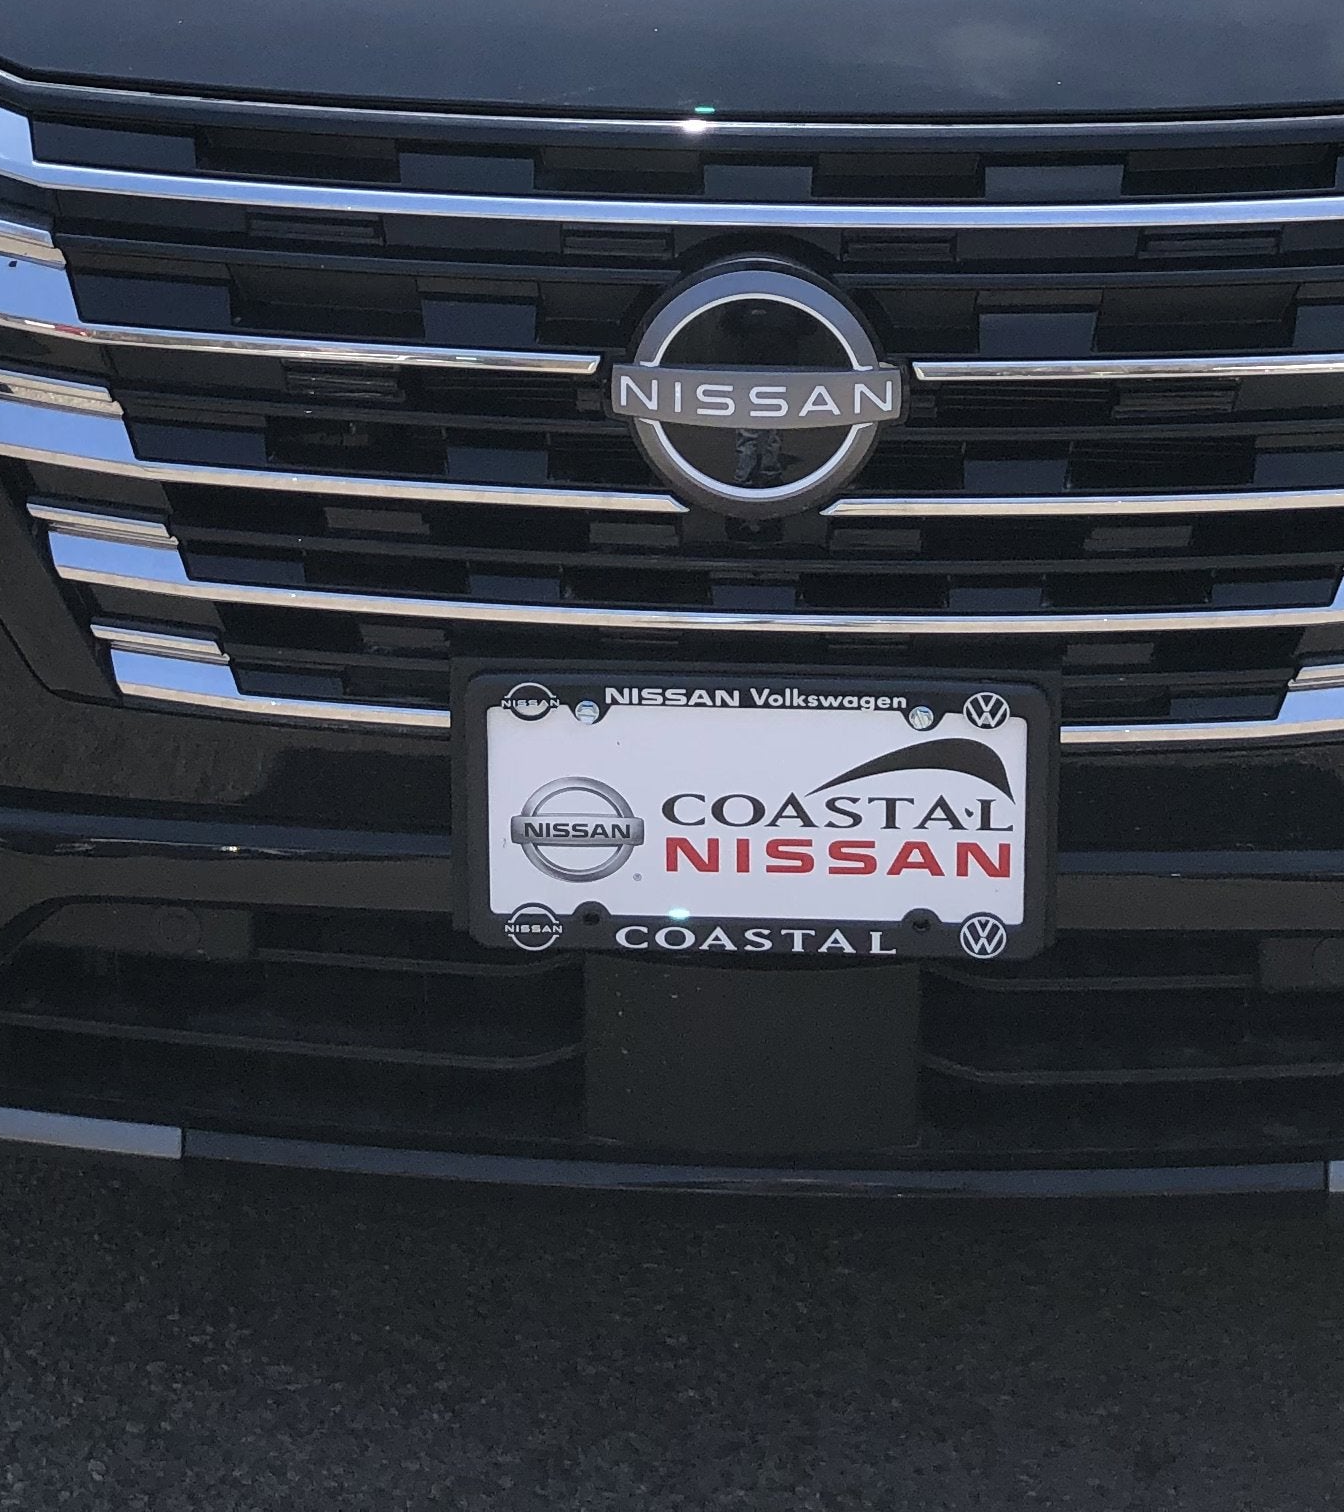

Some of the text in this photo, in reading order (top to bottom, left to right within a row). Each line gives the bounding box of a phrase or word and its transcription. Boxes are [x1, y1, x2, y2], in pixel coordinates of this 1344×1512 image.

[619, 375, 893, 418] NISSAN
[501, 698, 560, 709] NISSAN
[604, 686, 908, 712] NISSAN Volkswagen
[661, 791, 1014, 833] COASTAL
[523, 821, 631, 840] NISSAN
[665, 836, 1011, 879] NISSAN
[504, 923, 563, 934] NISSAN
[615, 925, 897, 956] COASTAL
